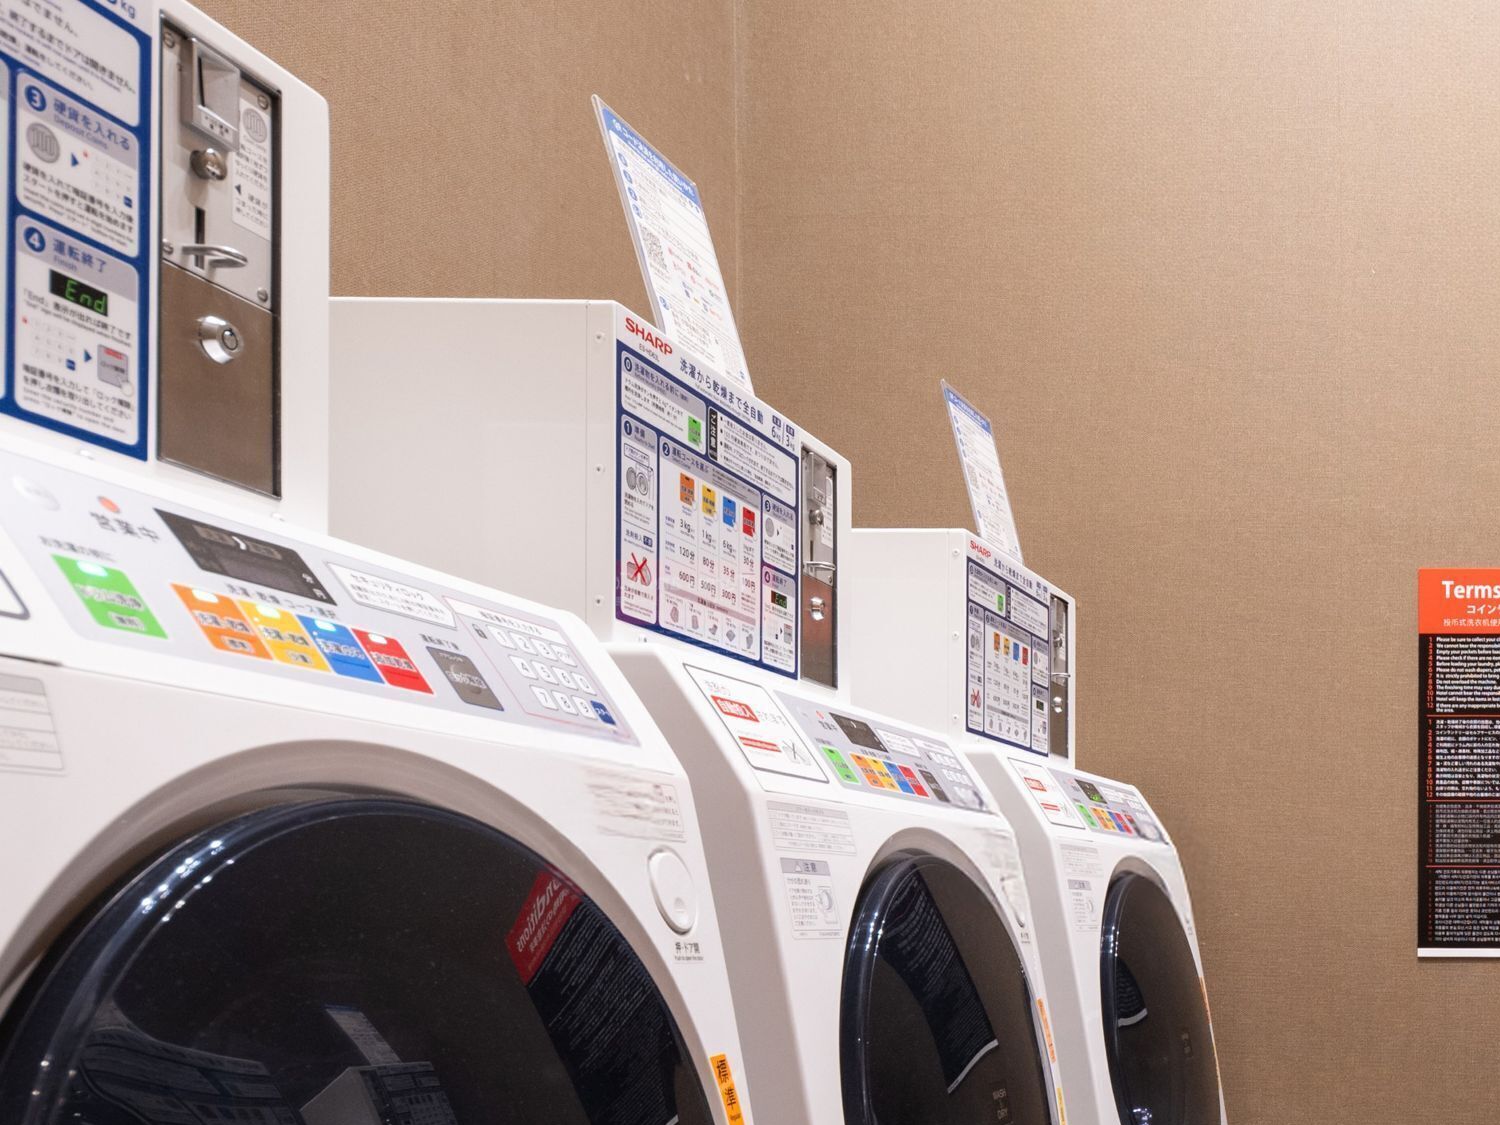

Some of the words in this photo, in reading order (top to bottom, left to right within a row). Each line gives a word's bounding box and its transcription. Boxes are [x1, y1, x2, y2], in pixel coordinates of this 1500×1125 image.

[28, 88, 41, 109] 3
[53, 99, 131, 151] 硬貨を入れる
[28, 230, 43, 251] 4
[52, 238, 107, 274] 運転終了
[64, 279, 107, 315] End
[625, 317, 673, 355] SHARP
[679, 357, 764, 425] 洗濯から乾燥まで全自動
[90, 511, 160, 542] 営業中
[680, 518, 691, 534] 3kg
[679, 546, 695, 562] 120分
[703, 557, 714, 569] 80分
[679, 571, 695, 585] 600円
[723, 566, 735, 578] 35分
[722, 588, 736, 603] 300円
